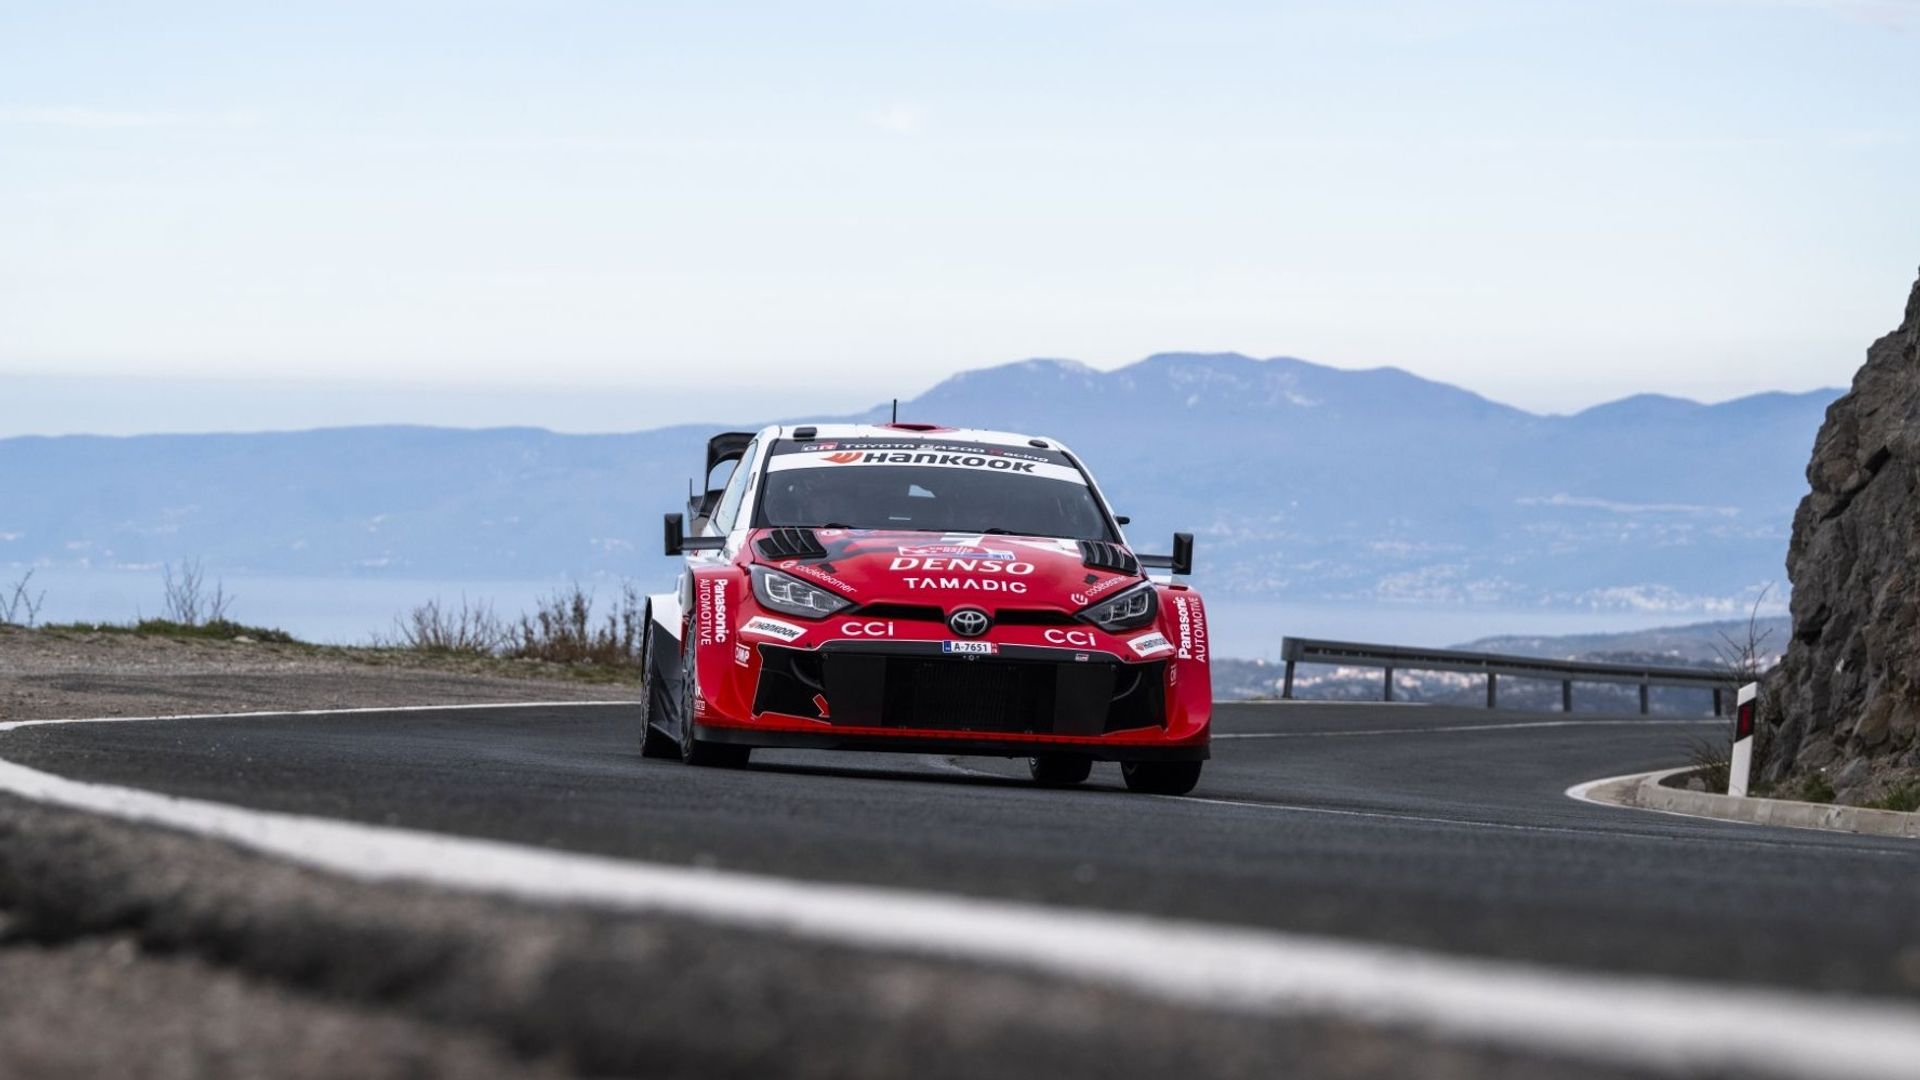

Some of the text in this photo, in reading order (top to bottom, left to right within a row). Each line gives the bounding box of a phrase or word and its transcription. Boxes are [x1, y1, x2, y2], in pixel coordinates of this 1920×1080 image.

[919, 444, 986, 453] GAZOO
[889, 557, 1035, 575] DENSO
[903, 577, 1028, 594] TAMADIC
[700, 578, 712, 645] AUTOMOTIVE
[714, 578, 729, 643] Panasonic
[1173, 596, 1192, 660] Panasonic
[1188, 596, 1206, 663] AUTOMOTIVE
[954, 642, 988, 652] A-7651
